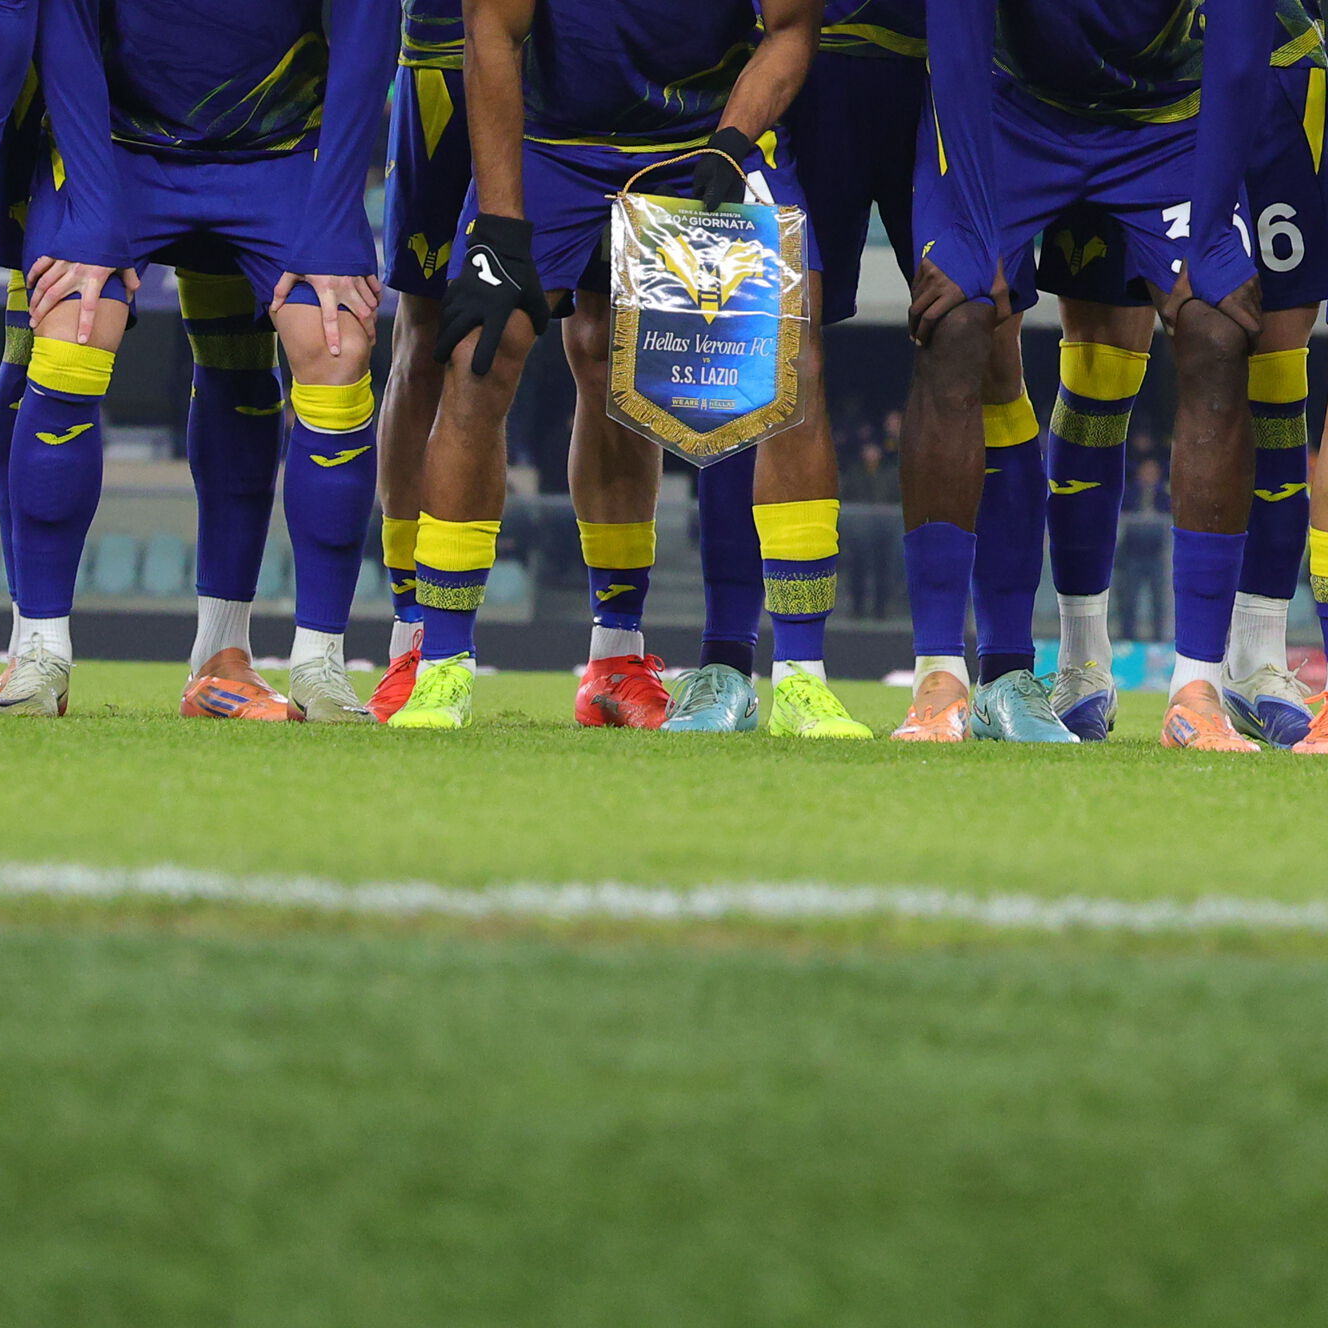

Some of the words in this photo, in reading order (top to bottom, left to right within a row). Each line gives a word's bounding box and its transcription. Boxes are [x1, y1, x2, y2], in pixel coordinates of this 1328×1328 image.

[688, 216, 755, 231] GIORNATA
[642, 331, 690, 352] Hellas
[694, 333, 747, 356] Verona
[750, 337, 773, 357] FC
[671, 365, 697, 384] S.S.
[700, 366, 739, 386] LAZIO
